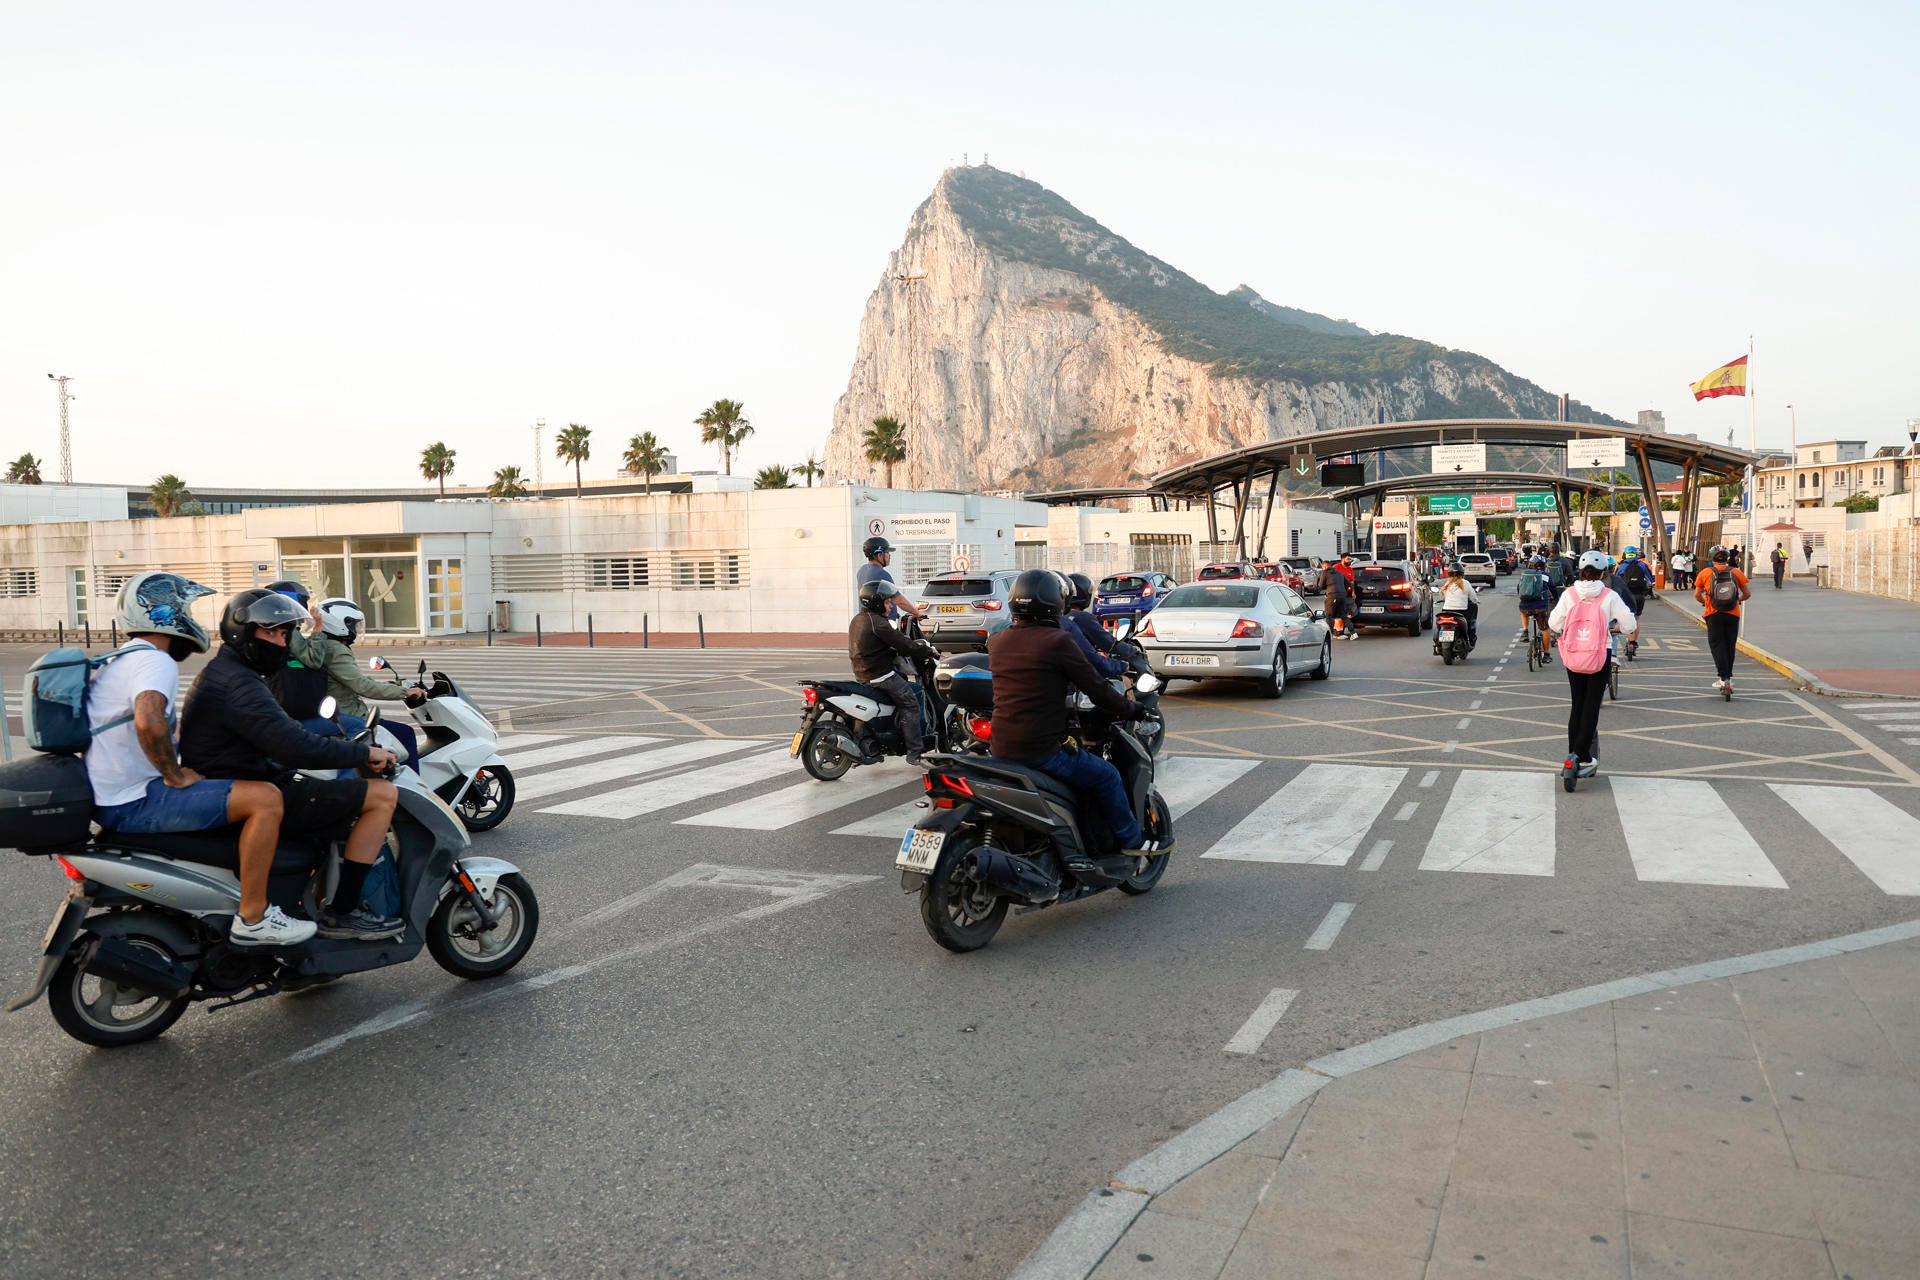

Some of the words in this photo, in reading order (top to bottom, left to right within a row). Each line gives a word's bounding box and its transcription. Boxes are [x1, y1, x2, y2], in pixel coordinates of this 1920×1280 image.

[1382, 521, 1409, 529] ADUANA
[1175, 657, 1194, 665] 5441
[1196, 657, 1211, 665] DHR
[911, 833, 942, 850] 3589
[906, 848, 930, 865] MNM
